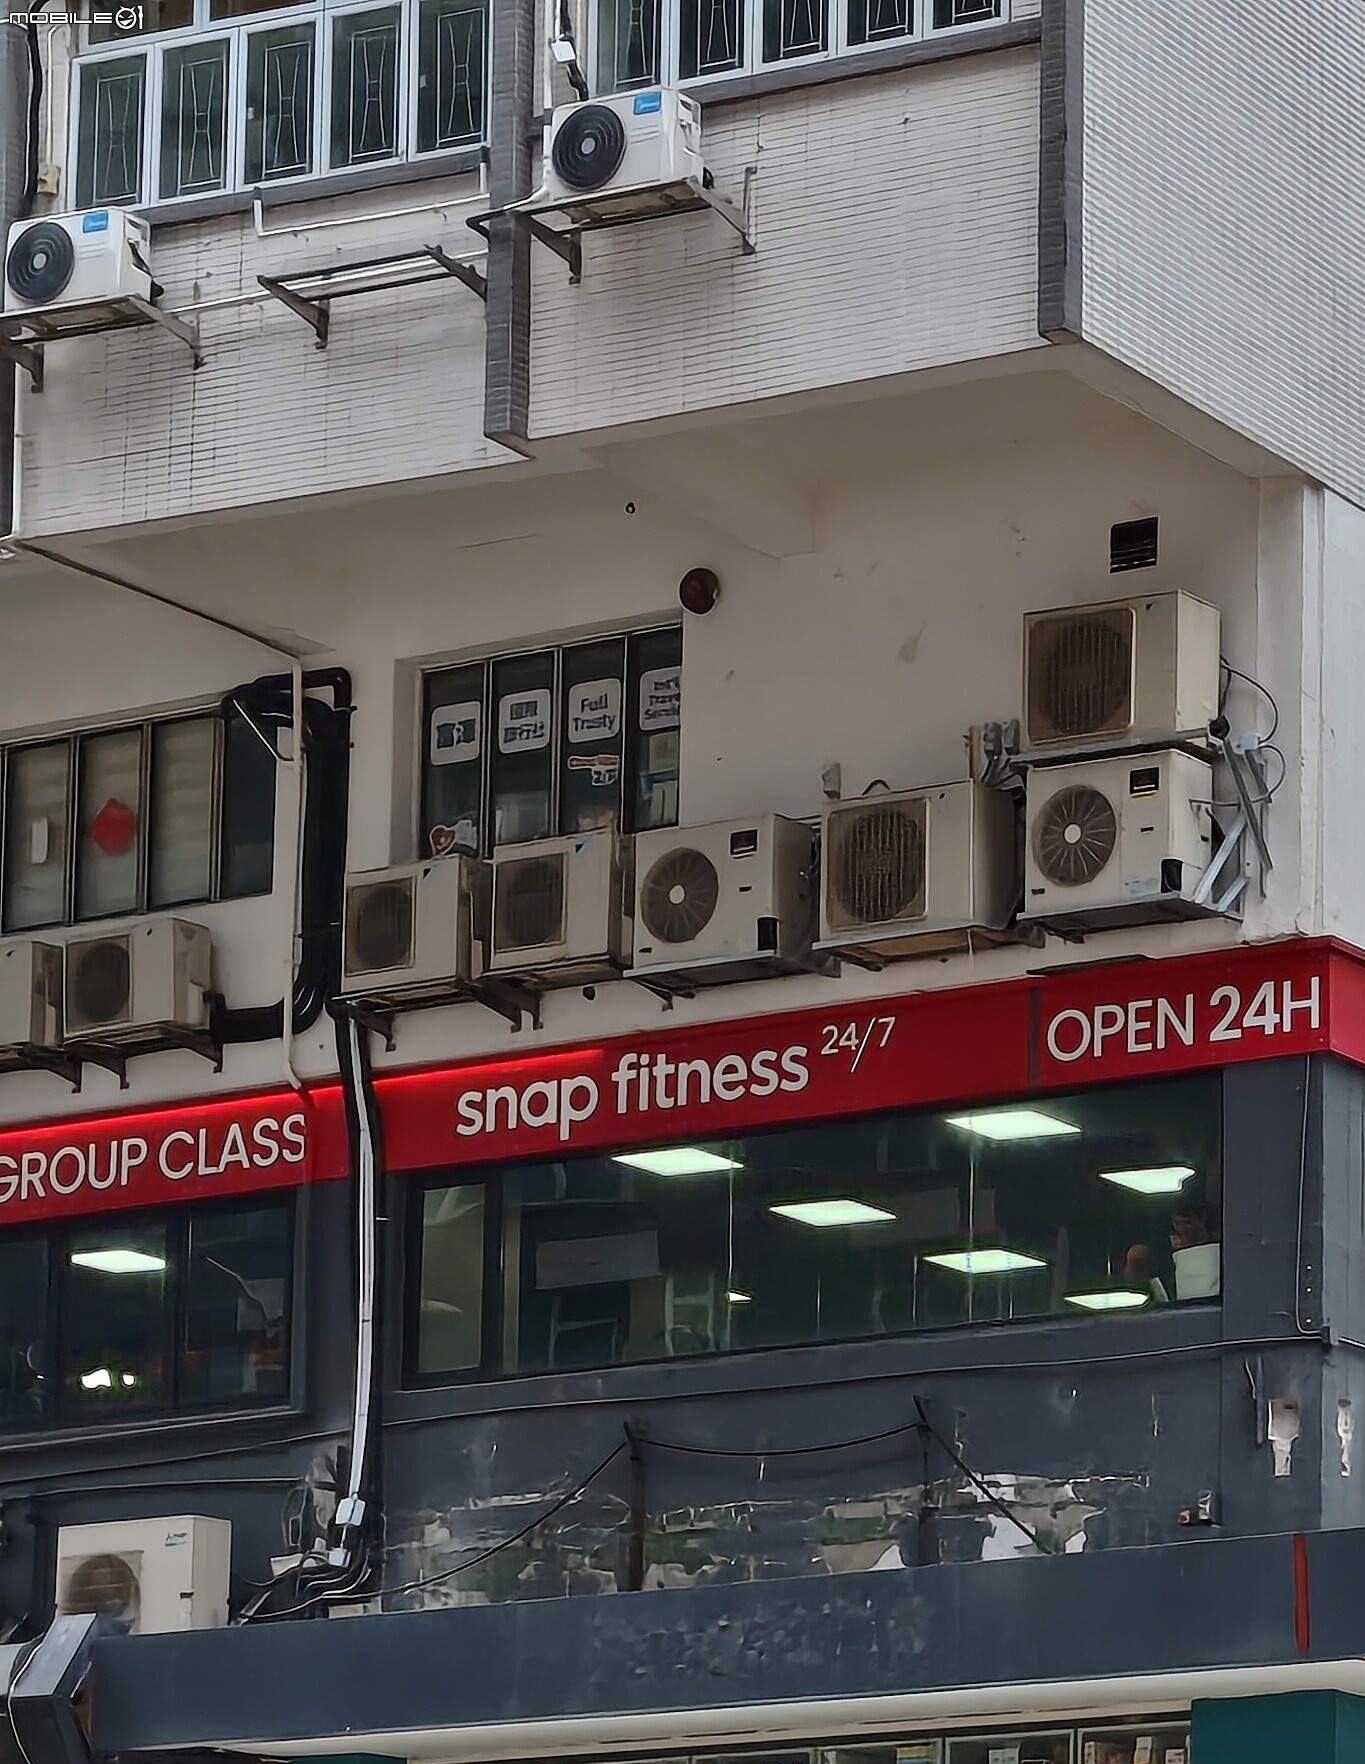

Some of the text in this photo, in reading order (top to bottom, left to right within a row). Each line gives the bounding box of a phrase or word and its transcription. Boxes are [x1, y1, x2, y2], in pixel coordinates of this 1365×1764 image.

[579, 693, 609, 713] Full
[1046, 975, 1322, 1063] OPEN 24H
[456, 1017, 896, 1141] snap fitness 24/7
[0, 1112, 307, 1205] GROUP CLASS
